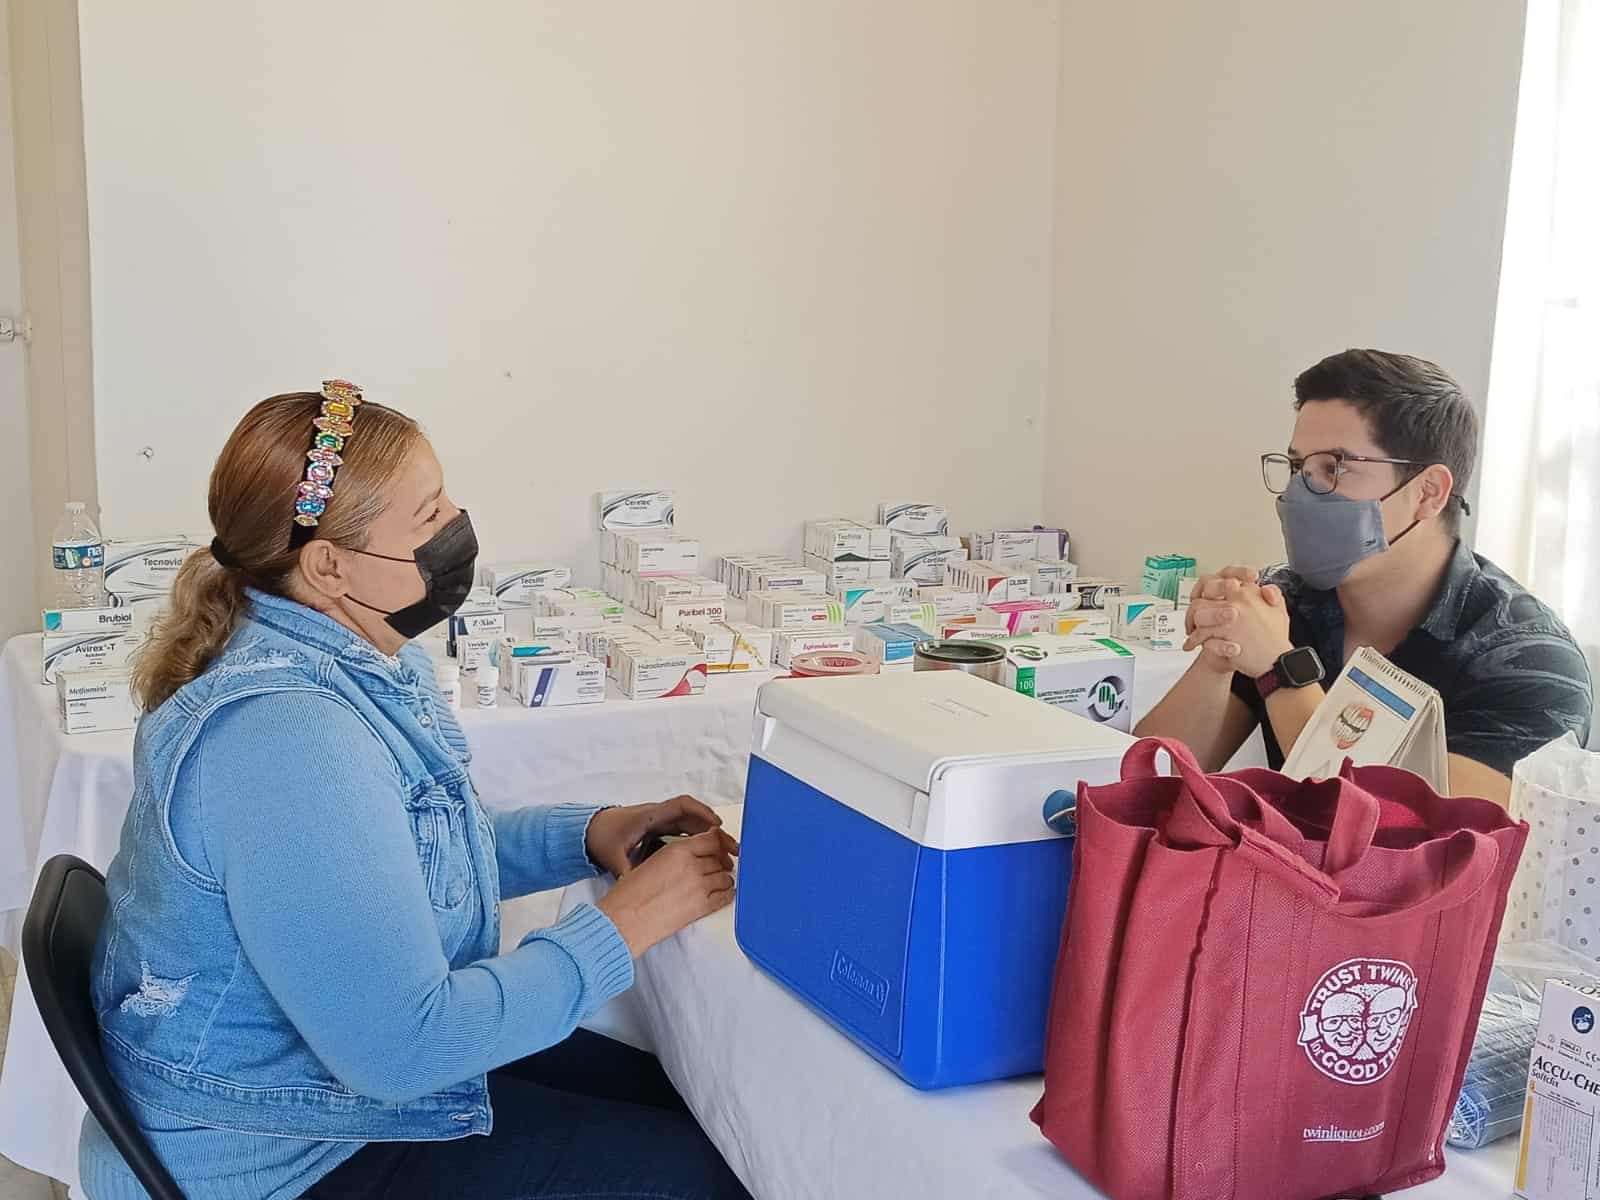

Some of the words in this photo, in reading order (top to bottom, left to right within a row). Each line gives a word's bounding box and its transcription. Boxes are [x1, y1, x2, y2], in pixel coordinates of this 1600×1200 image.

[142, 557, 183, 567] Tecnovid
[706, 607, 722, 615] 300
[98, 613, 132, 624] Brubiol
[1019, 681, 1034, 690] 100
[1310, 964, 1362, 1011] TRUST
[1367, 964, 1413, 990] TWINS
[1321, 1050, 1378, 1079] GOOD
[1532, 1055, 1600, 1096] ACCU-CHE
